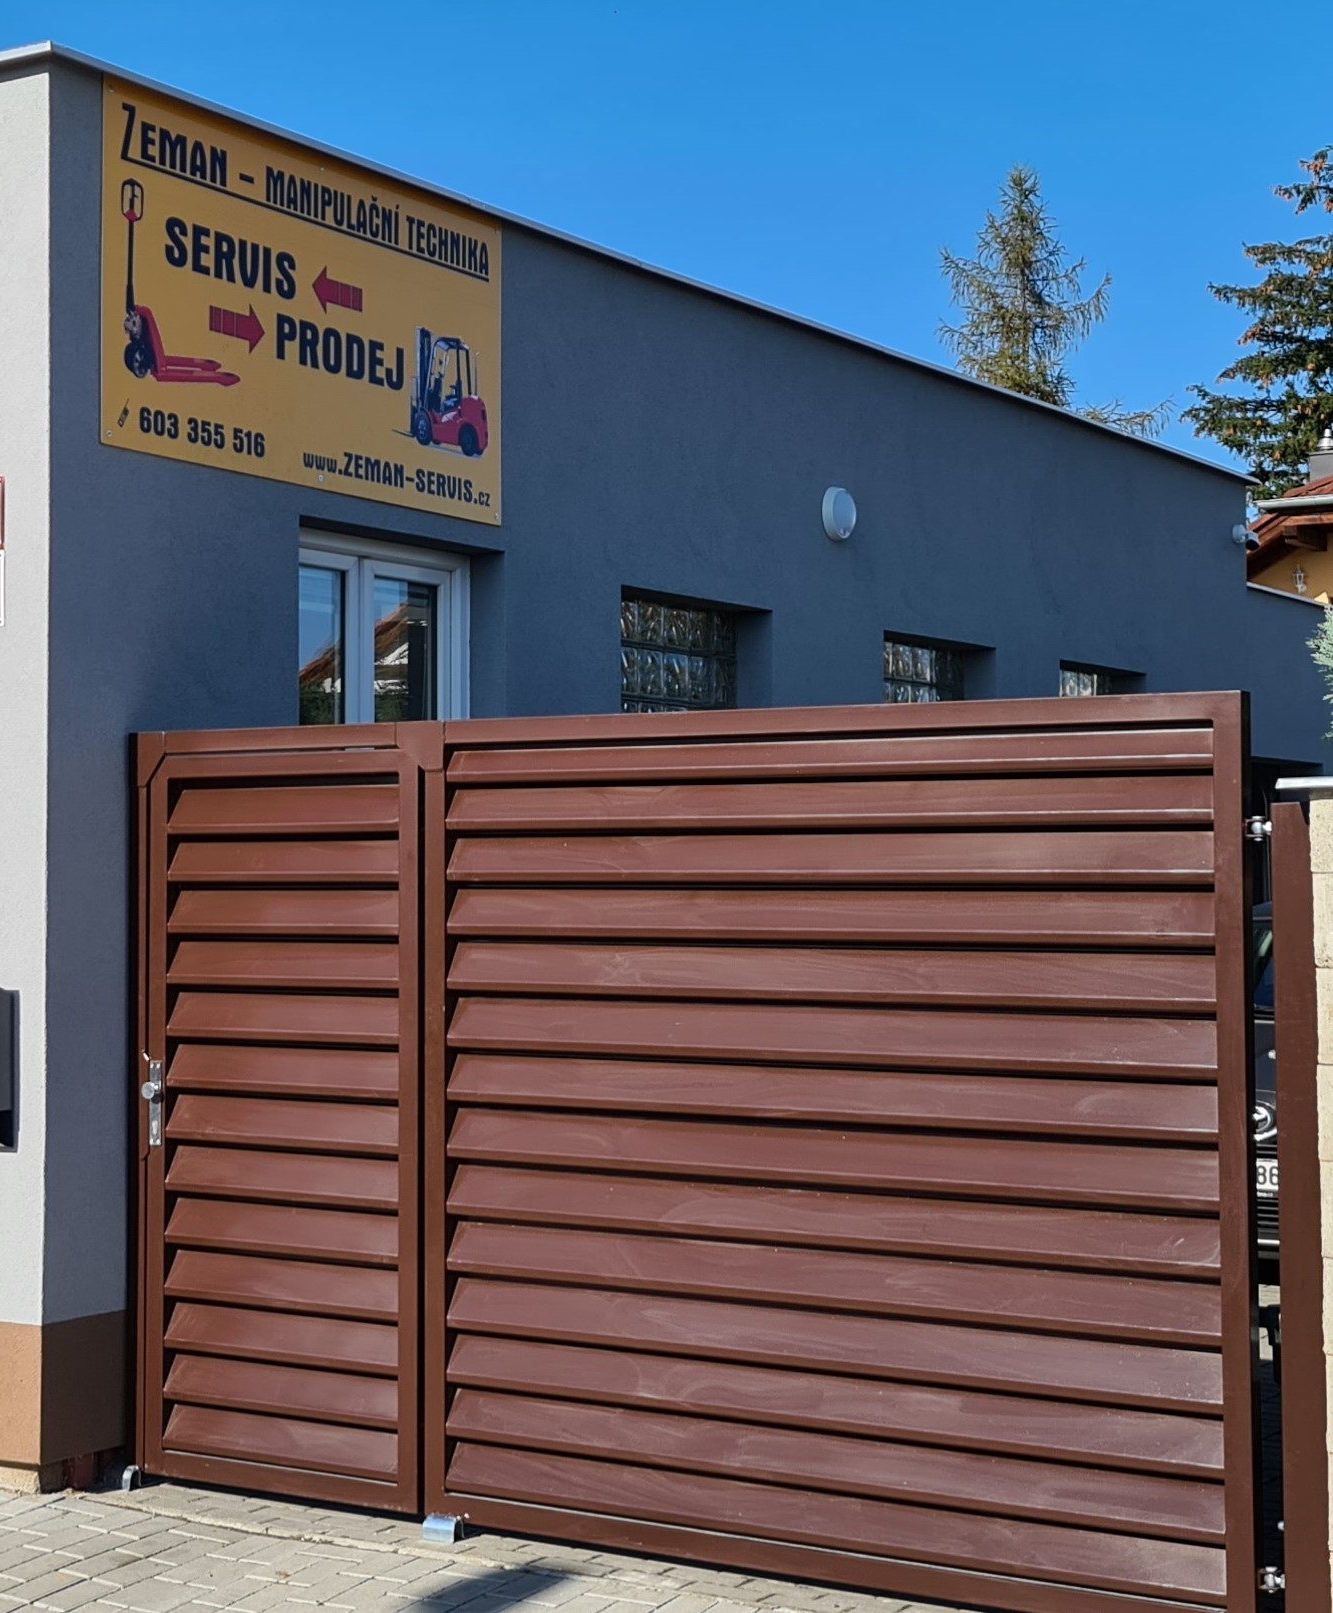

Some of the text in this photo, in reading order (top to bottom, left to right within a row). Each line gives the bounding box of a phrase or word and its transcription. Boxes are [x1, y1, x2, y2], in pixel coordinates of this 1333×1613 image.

[121, 102, 227, 188] ZEMAN
[265, 166, 401, 246] MANIPULAČNÍ
[406, 215, 490, 277] TECHNIKA
[165, 216, 297, 300] SERVIS
[276, 312, 404, 391] PRODEJ
[139, 406, 266, 459] 603 355 516
[302, 450, 491, 508] www.ZEMAN-SERVIS.cz
